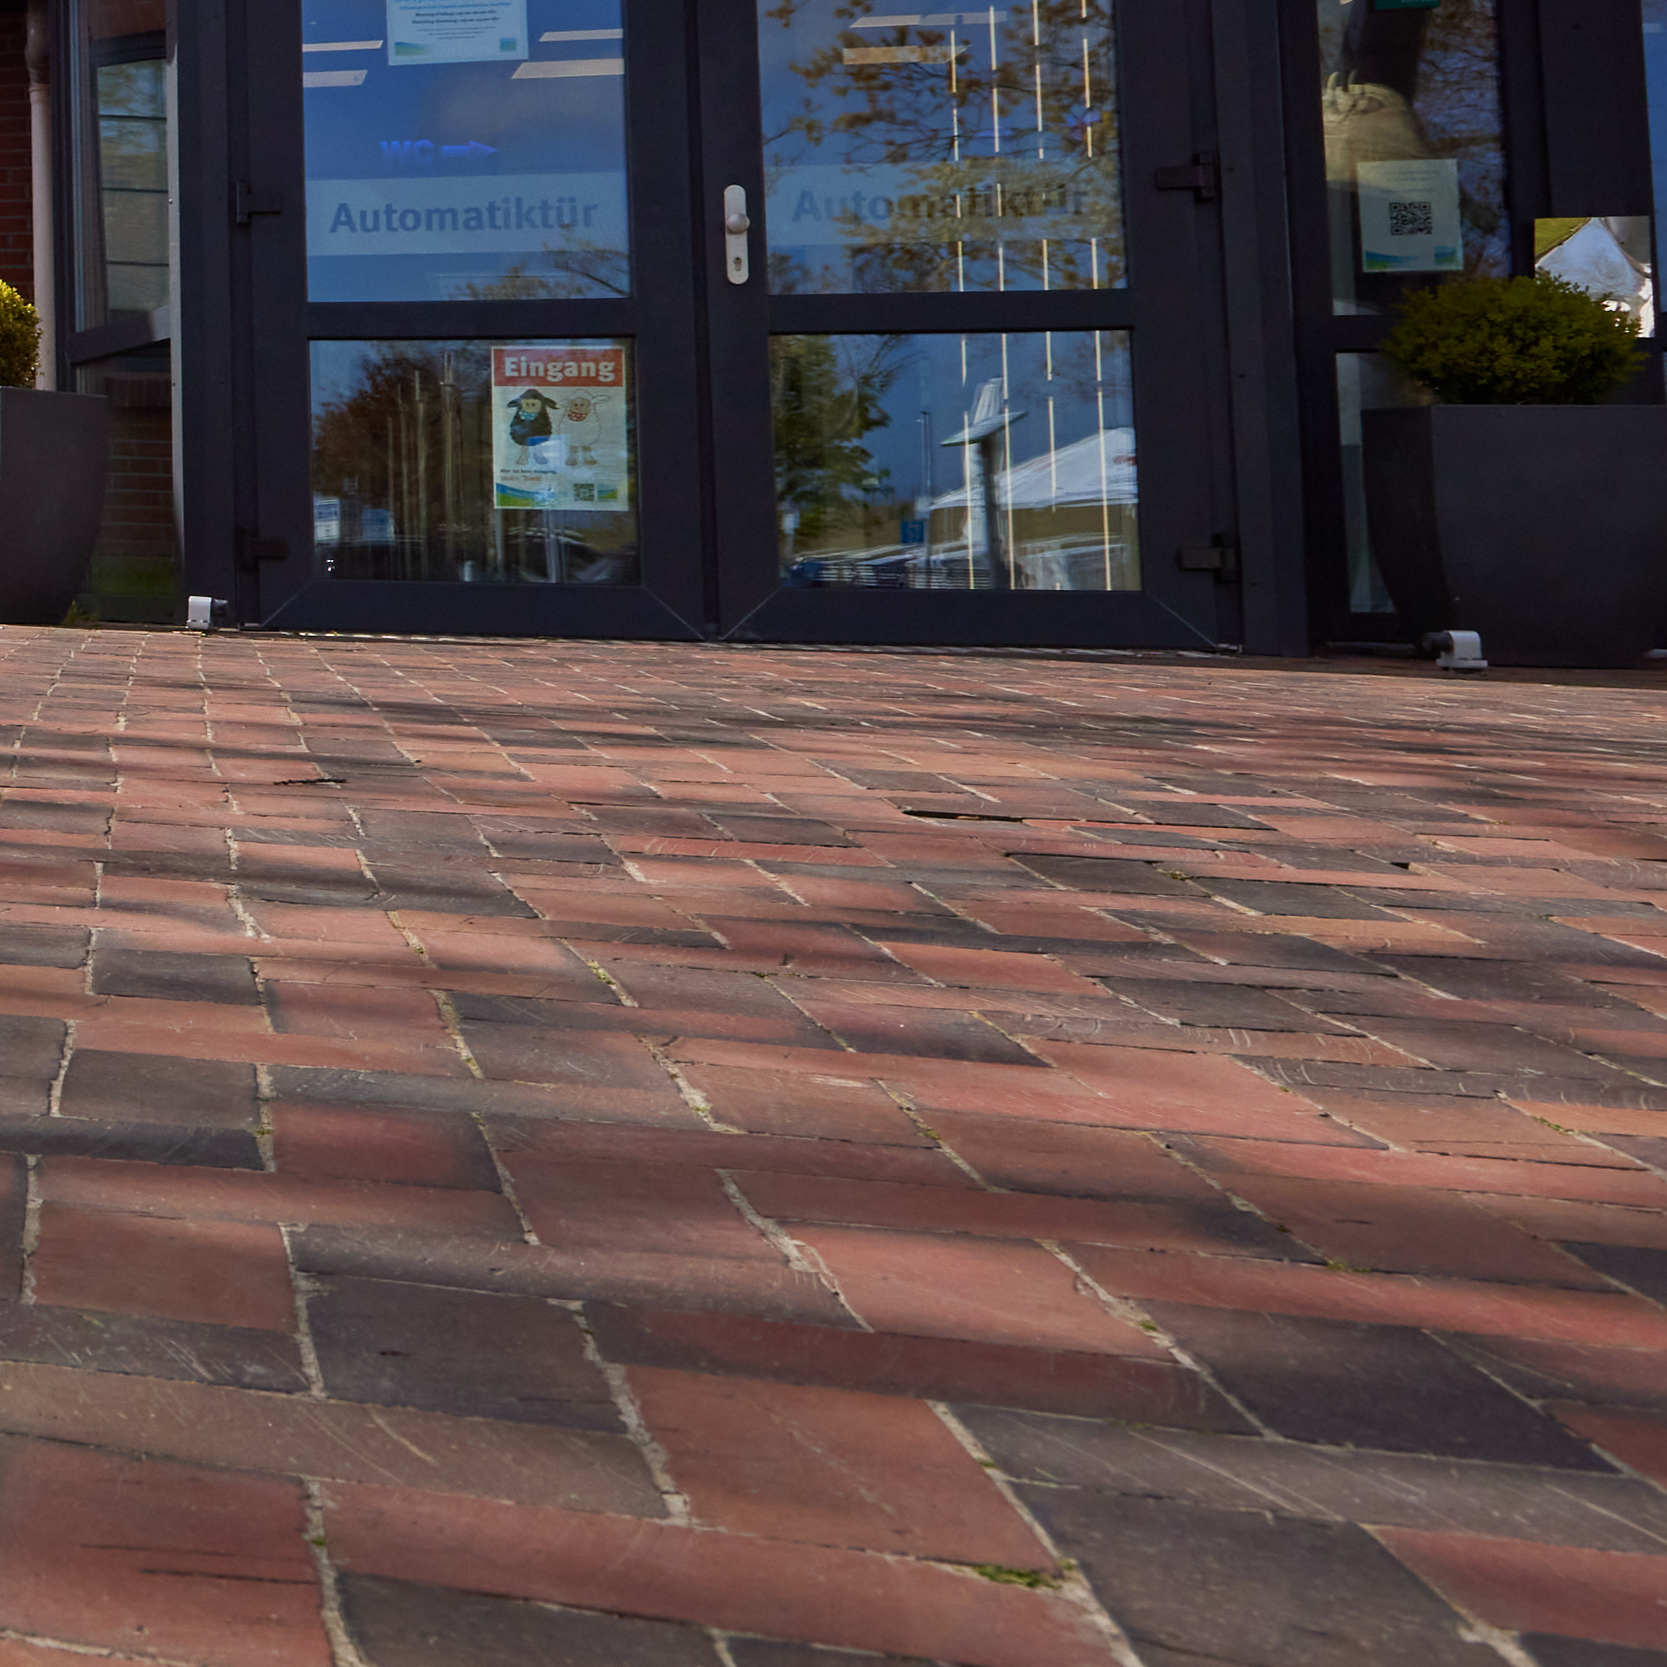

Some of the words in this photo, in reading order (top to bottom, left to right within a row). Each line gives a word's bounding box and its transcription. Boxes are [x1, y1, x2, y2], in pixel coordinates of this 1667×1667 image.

[379, 139, 435, 165] WC
[329, 196, 599, 233] Automatiktür
[504, 355, 616, 382] Eingang
